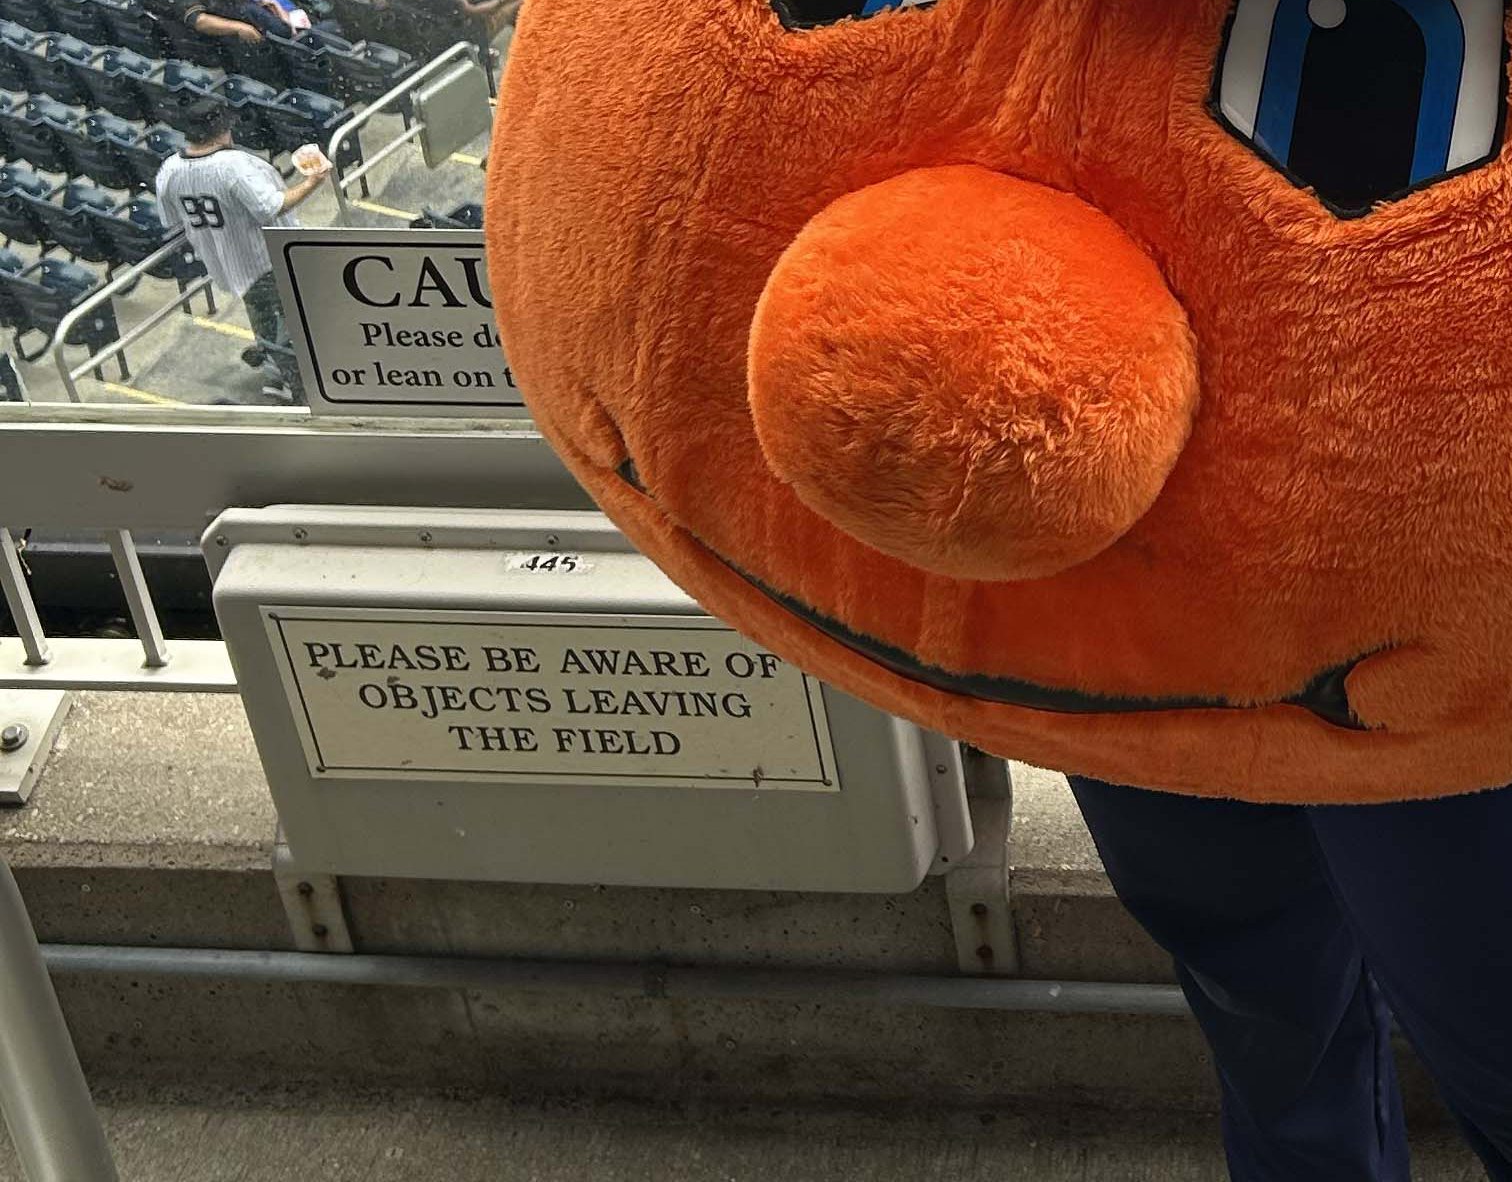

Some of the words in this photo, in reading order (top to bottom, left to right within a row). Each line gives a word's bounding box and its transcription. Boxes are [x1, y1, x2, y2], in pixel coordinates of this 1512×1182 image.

[179, 195, 225, 229] 99
[359, 321, 465, 348] Please
[331, 368, 366, 386] or
[373, 361, 445, 387] lean
[452, 369, 496, 388] on
[521, 555, 579, 573] 445
[303, 641, 470, 672] PLEASE
[481, 646, 541, 674] BE
[559, 649, 711, 679] AWARE
[725, 652, 784, 680] OF
[358, 684, 552, 719] OBJECTS
[566, 688, 752, 719] LEAVING
[447, 725, 539, 753] THE
[555, 727, 682, 756] FIELD
